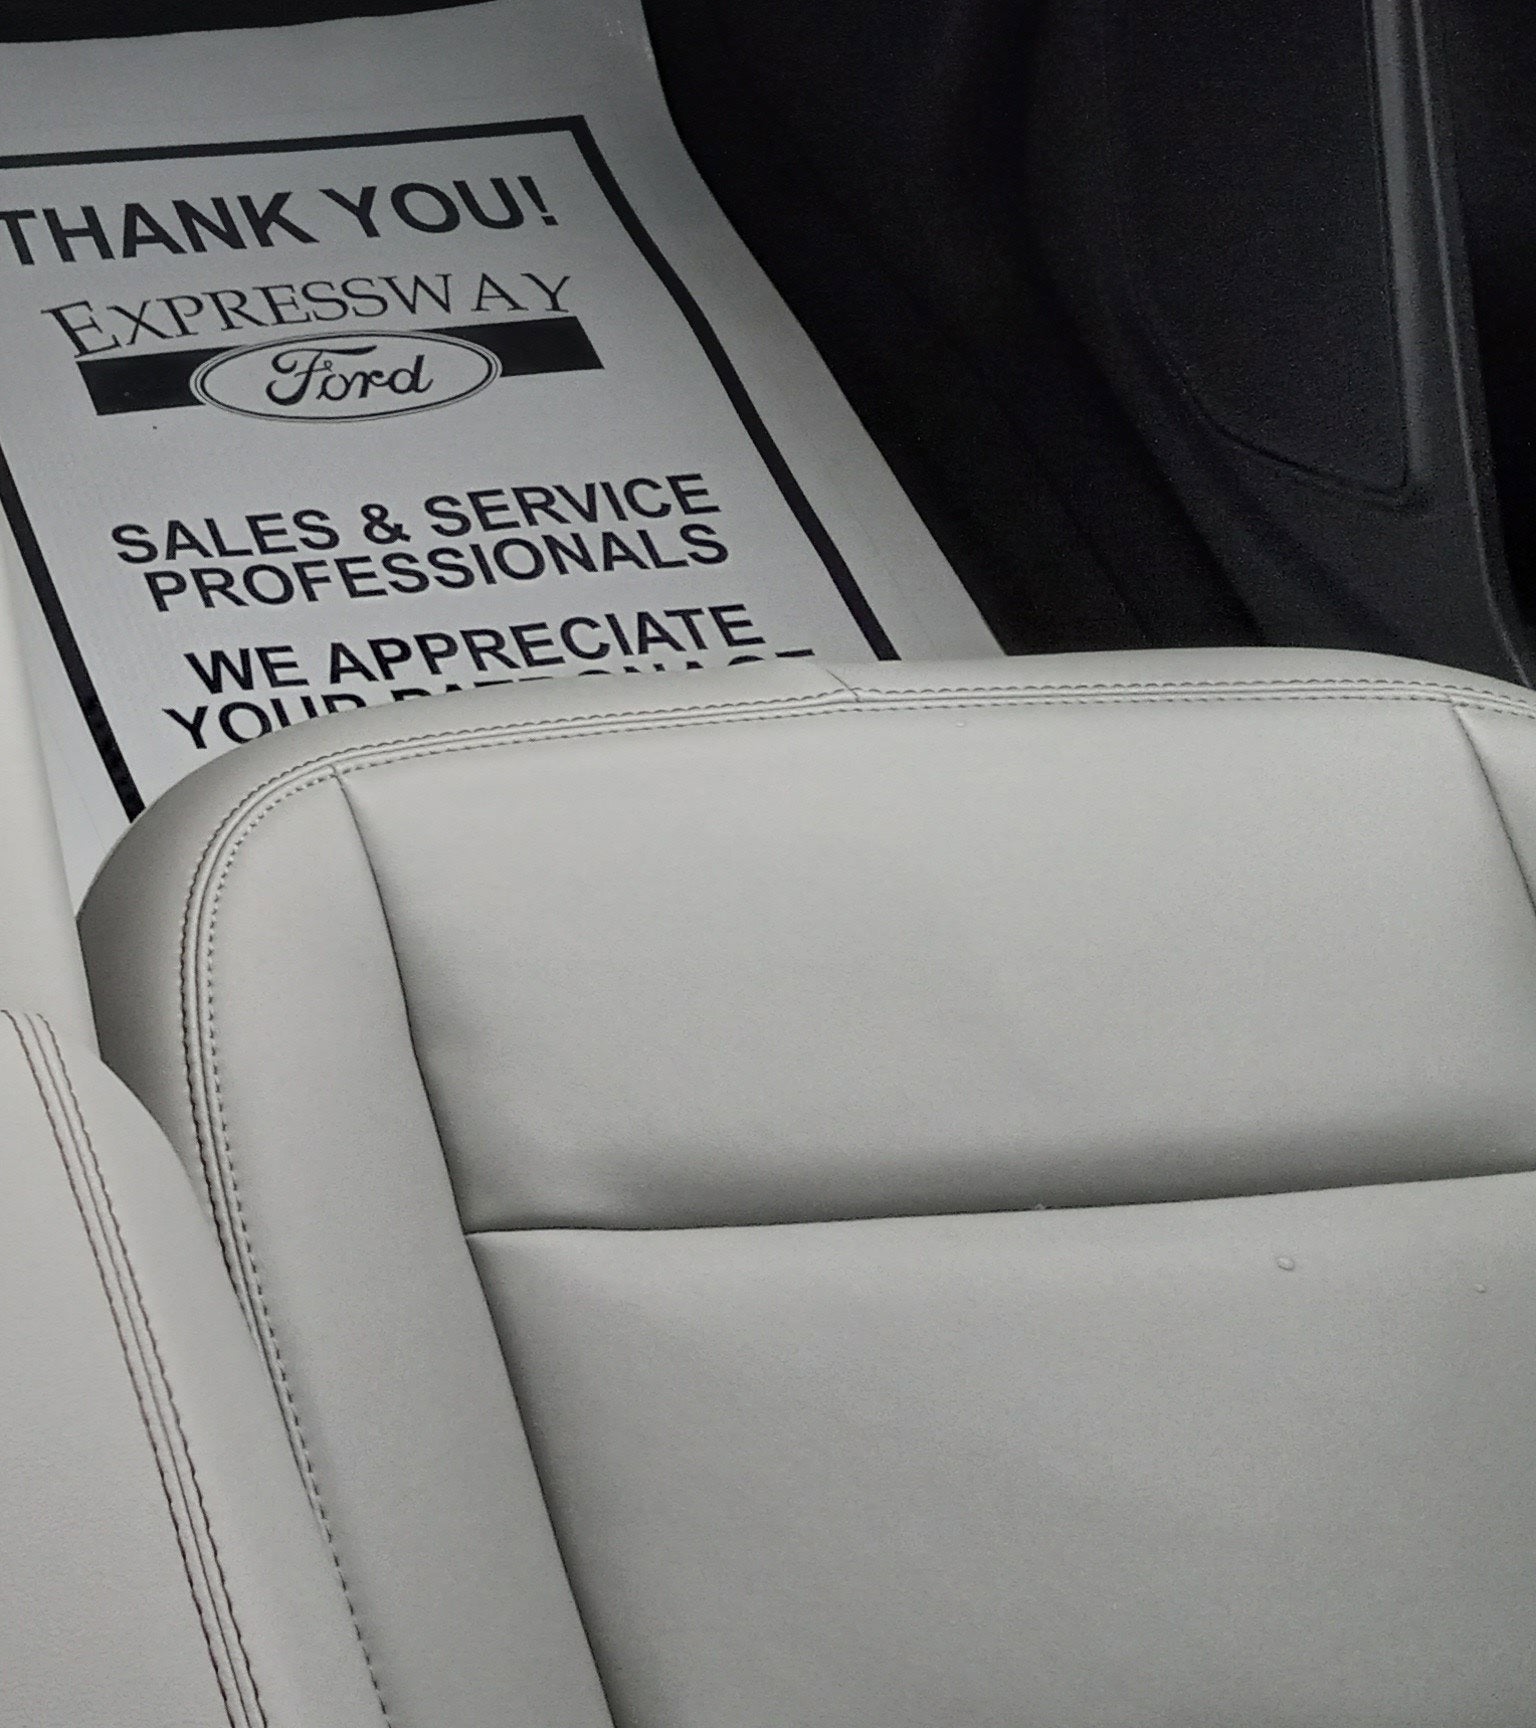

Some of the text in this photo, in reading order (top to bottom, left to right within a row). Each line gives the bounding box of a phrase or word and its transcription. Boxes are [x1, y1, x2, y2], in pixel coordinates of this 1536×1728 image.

[319, 174, 560, 239] YOU!
[41, 272, 572, 358] EXPRESSWAY
[266, 344, 434, 407] Ford
[110, 473, 723, 565] SALES & SERVICE
[143, 522, 731, 613] PROFESSIONALS
[183, 644, 310, 695] WE
[326, 603, 766, 685] APPRECIATE
